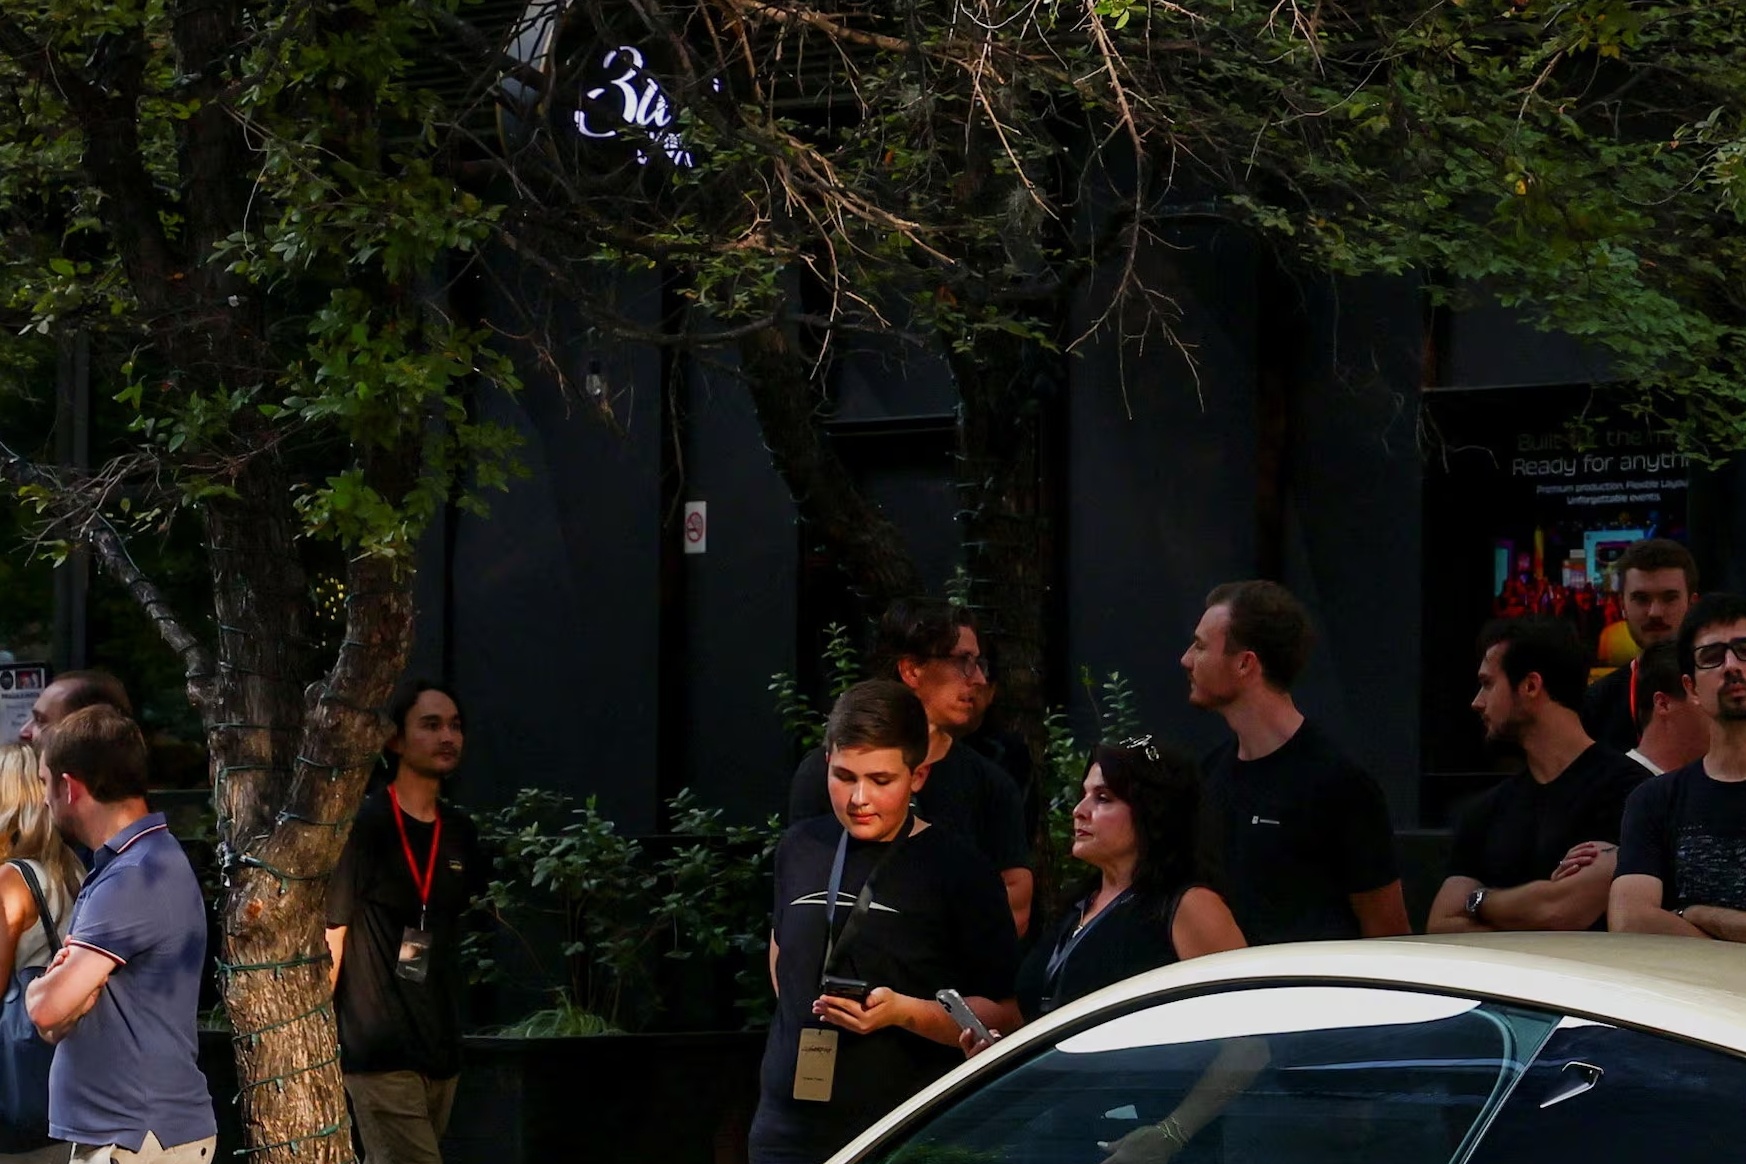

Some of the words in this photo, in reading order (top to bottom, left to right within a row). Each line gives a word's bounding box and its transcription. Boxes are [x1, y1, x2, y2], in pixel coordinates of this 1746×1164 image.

[1512, 456, 1577, 478] Ready
[1583, 453, 1612, 474] for
[1619, 450, 1690, 474] anythi
